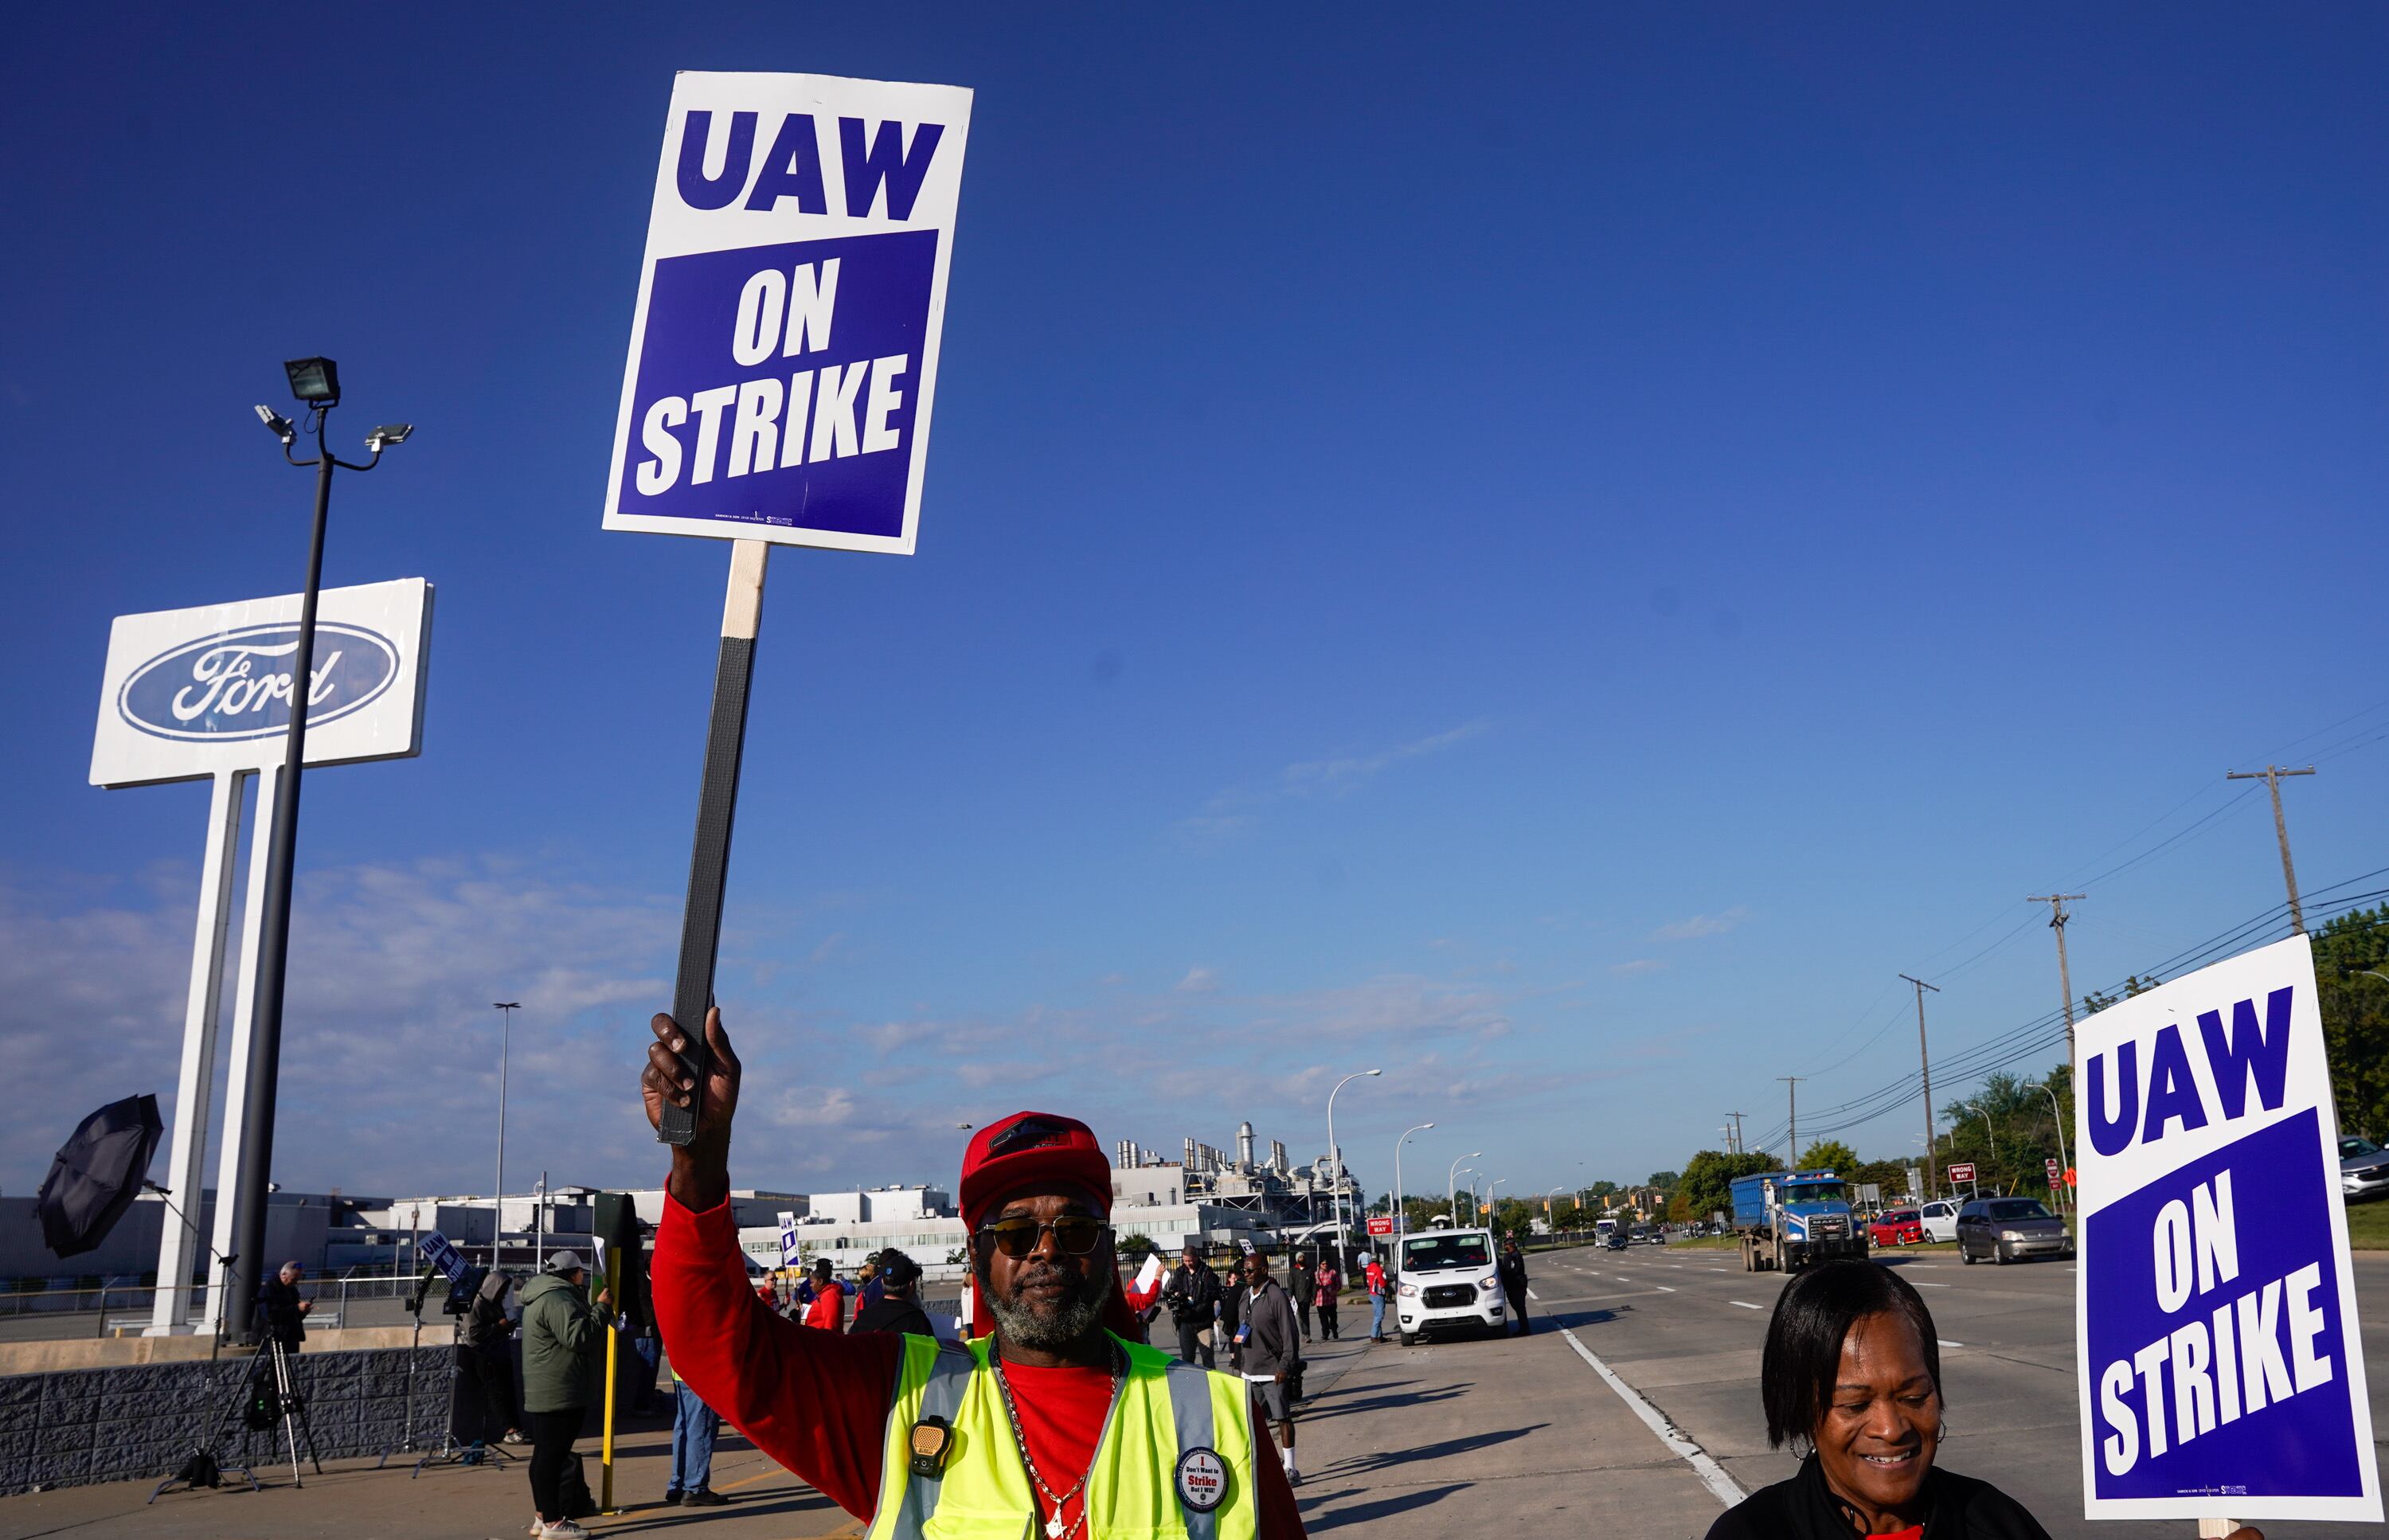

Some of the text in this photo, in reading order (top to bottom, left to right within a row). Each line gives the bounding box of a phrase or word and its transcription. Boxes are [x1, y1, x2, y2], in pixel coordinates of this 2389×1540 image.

[677, 111, 945, 221] UAW
[733, 258, 841, 366] ON
[636, 354, 909, 496] STRIKE
[171, 640, 342, 721] Ford
[2087, 986, 2293, 1157] UAW
[421, 1234, 447, 1255] UAW
[2154, 1169, 2239, 1314] ON
[2101, 1261, 2333, 1476] STRIKE
[1188, 1475, 1217, 1487] Strike
[1201, 1456, 1204, 1466] I
